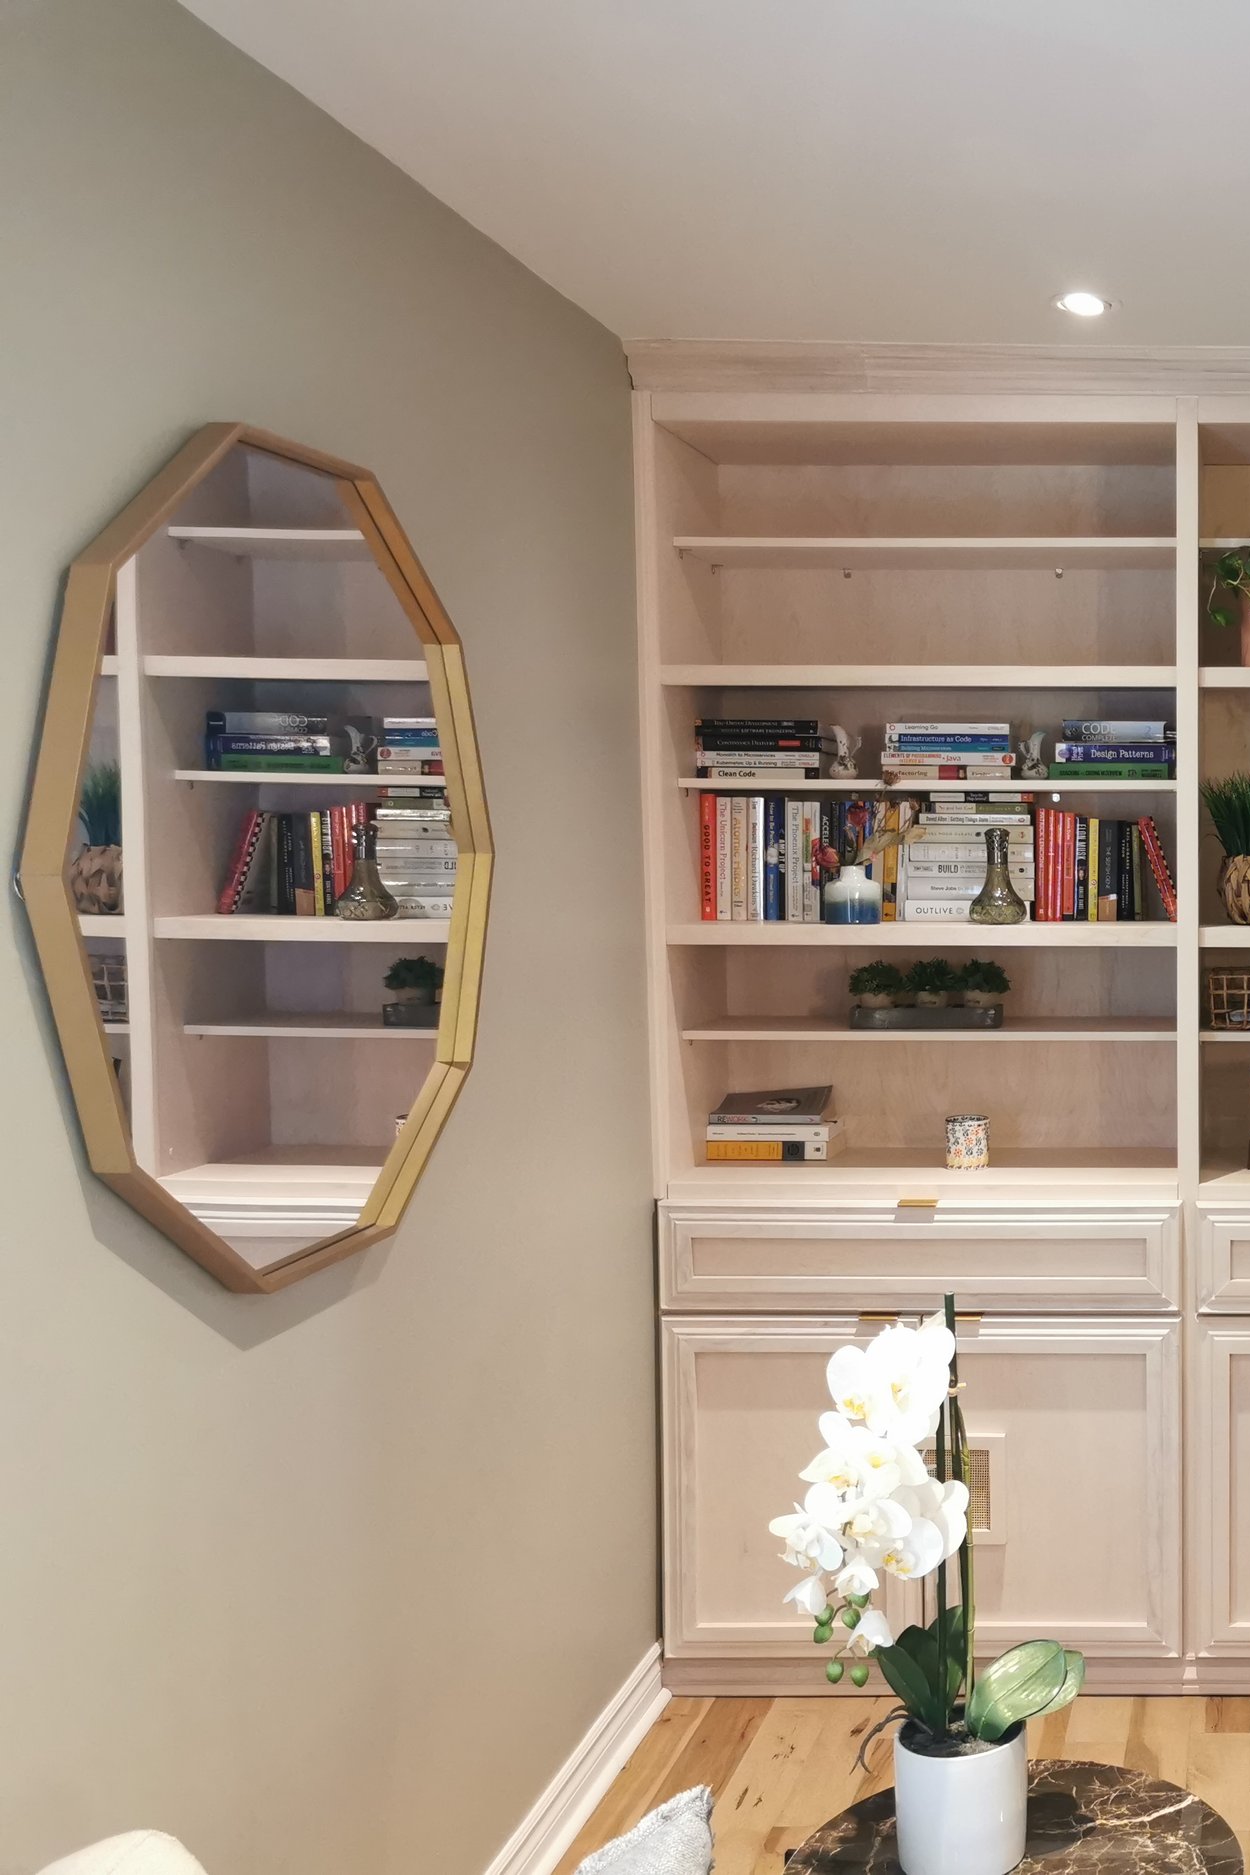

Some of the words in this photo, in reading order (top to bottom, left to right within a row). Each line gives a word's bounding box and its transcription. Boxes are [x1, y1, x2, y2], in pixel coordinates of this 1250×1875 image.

[900, 735, 945, 743] Infrastructure
[1091, 749, 1117, 760] Design
[1120, 749, 1154, 758] Patterns
[718, 770, 737, 778] Clean
[1078, 824, 1086, 840] ELON
[733, 818, 741, 857] Atomic
[1078, 841, 1086, 860] MUSK
[705, 856, 710, 867] TO
[779, 863, 785, 873] UP
[938, 865, 958, 873] BUILD
[717, 1115, 749, 1123] REWORK
